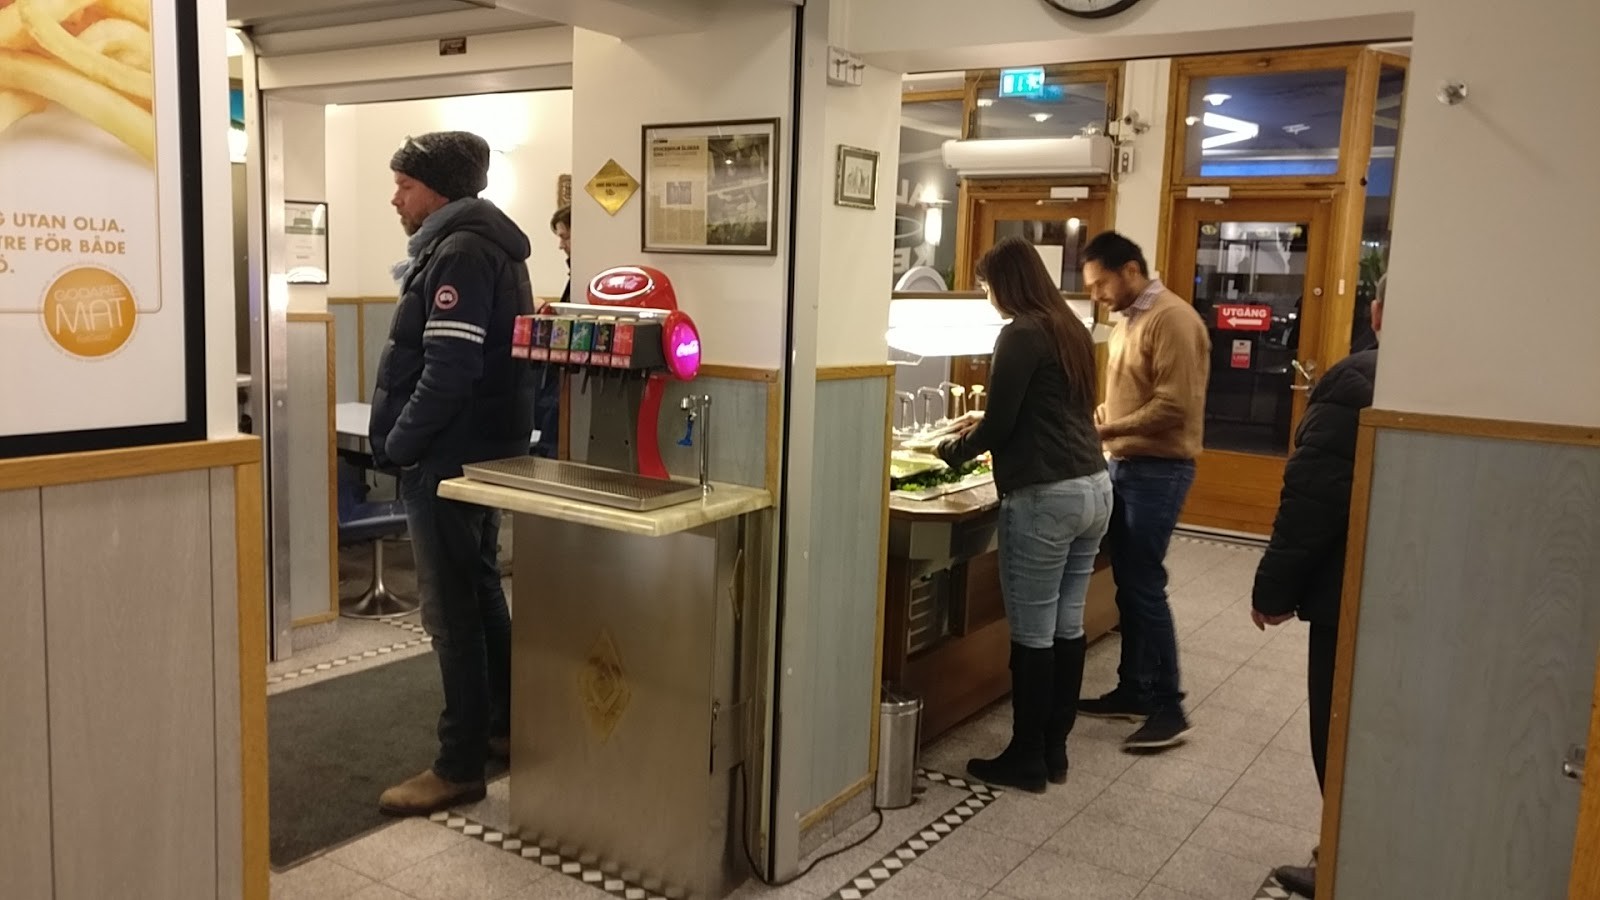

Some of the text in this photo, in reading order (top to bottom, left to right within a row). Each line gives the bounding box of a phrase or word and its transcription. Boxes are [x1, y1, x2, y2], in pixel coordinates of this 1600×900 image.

[13, 212, 66, 229] UTAN
[73, 216, 125, 233] OLJA.
[34, 233, 72, 252] FÖR
[80, 236, 126, 255] BÅDE
[54, 285, 120, 300] GODARE
[55, 297, 127, 335] MAT
[1222, 307, 1267, 318] UTGÅNG
